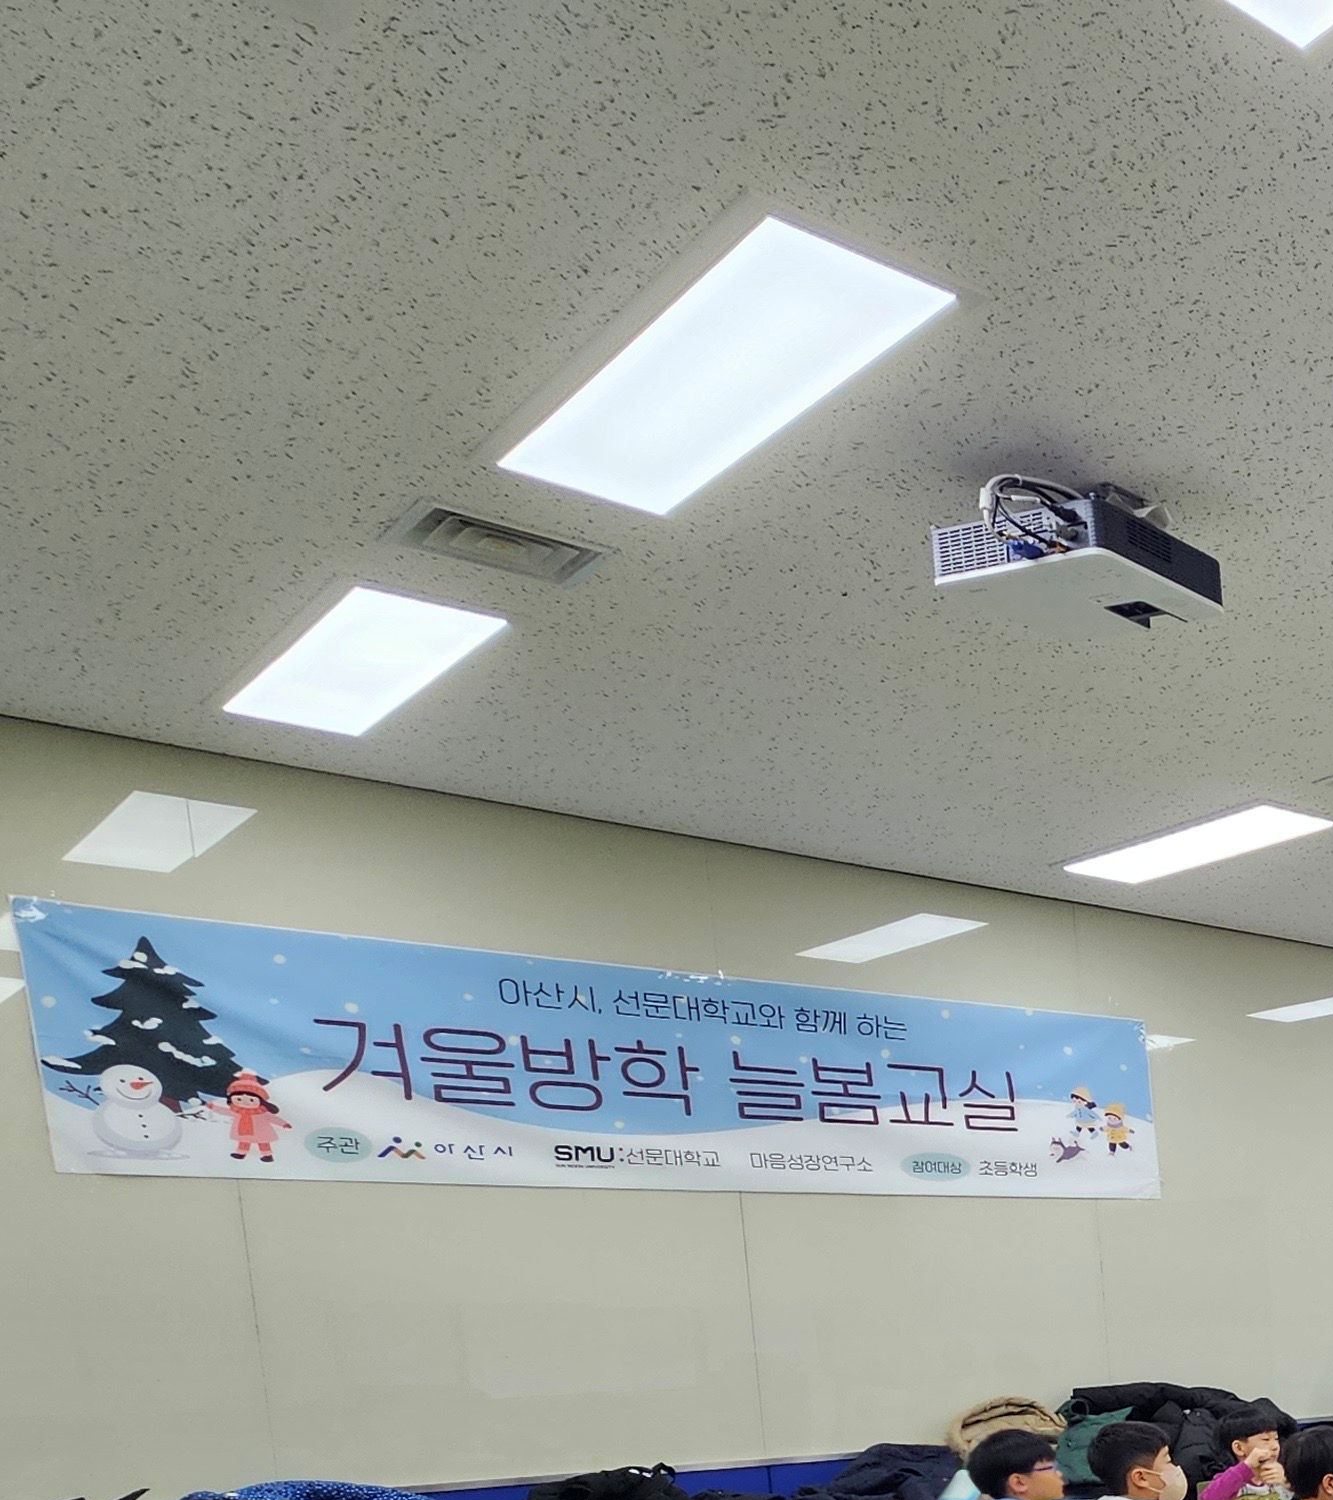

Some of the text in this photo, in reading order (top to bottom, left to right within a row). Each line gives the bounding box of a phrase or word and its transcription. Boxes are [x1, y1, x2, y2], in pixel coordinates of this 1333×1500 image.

[499, 977, 907, 1041] 아산시, 선문대학교와 함께 하는
[312, 1018, 1019, 1132] 겨울방학 늘봄교실
[316, 1136, 360, 1155] 주관
[749, 1152, 874, 1173] 마음성장연구소
[912, 1159, 962, 1176] 참여대상
[978, 1159, 1038, 1178] 초등학생
